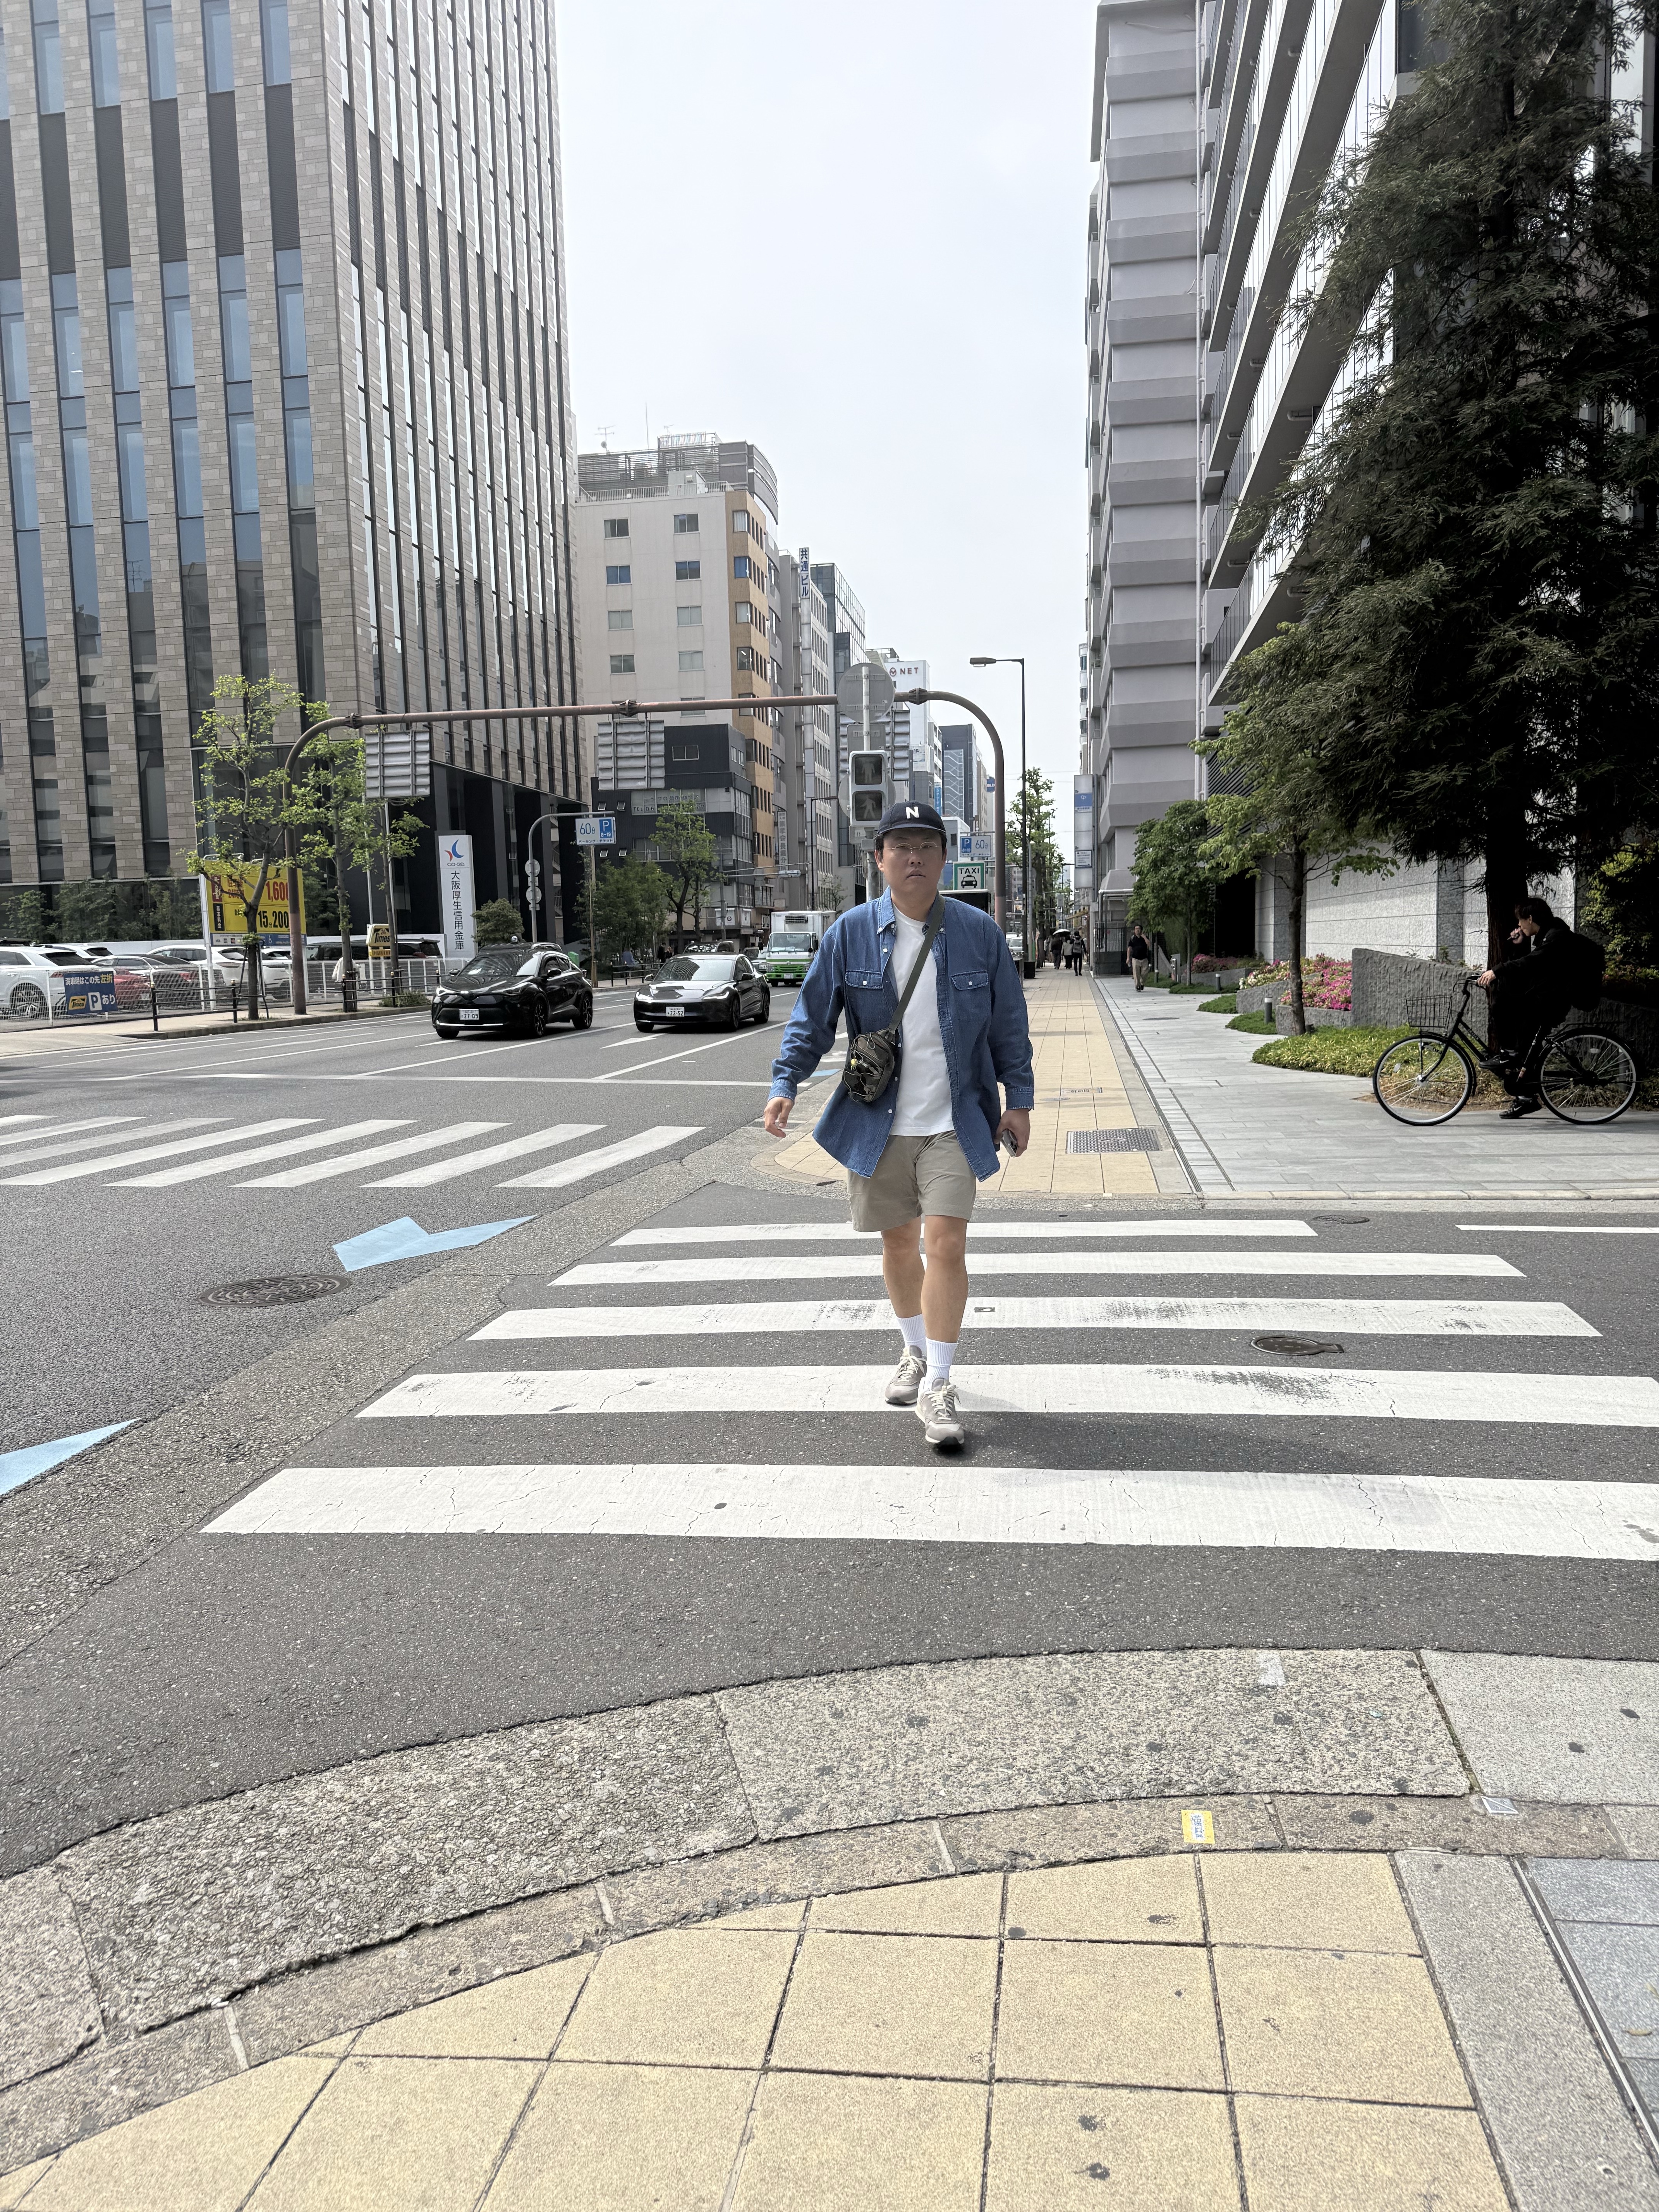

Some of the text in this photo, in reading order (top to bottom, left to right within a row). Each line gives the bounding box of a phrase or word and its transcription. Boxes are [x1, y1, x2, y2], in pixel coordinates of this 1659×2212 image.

[800, 548, 809, 596] 共通ビル
[900, 667, 919, 675] NET
[905, 806, 919, 819] N
[603, 820, 609, 831] P
[964, 838, 970, 848] P
[451, 870, 464, 950] 大阪厚生信用金庫
[91, 994, 98, 1008] P
[101, 994, 115, 1005] あり
